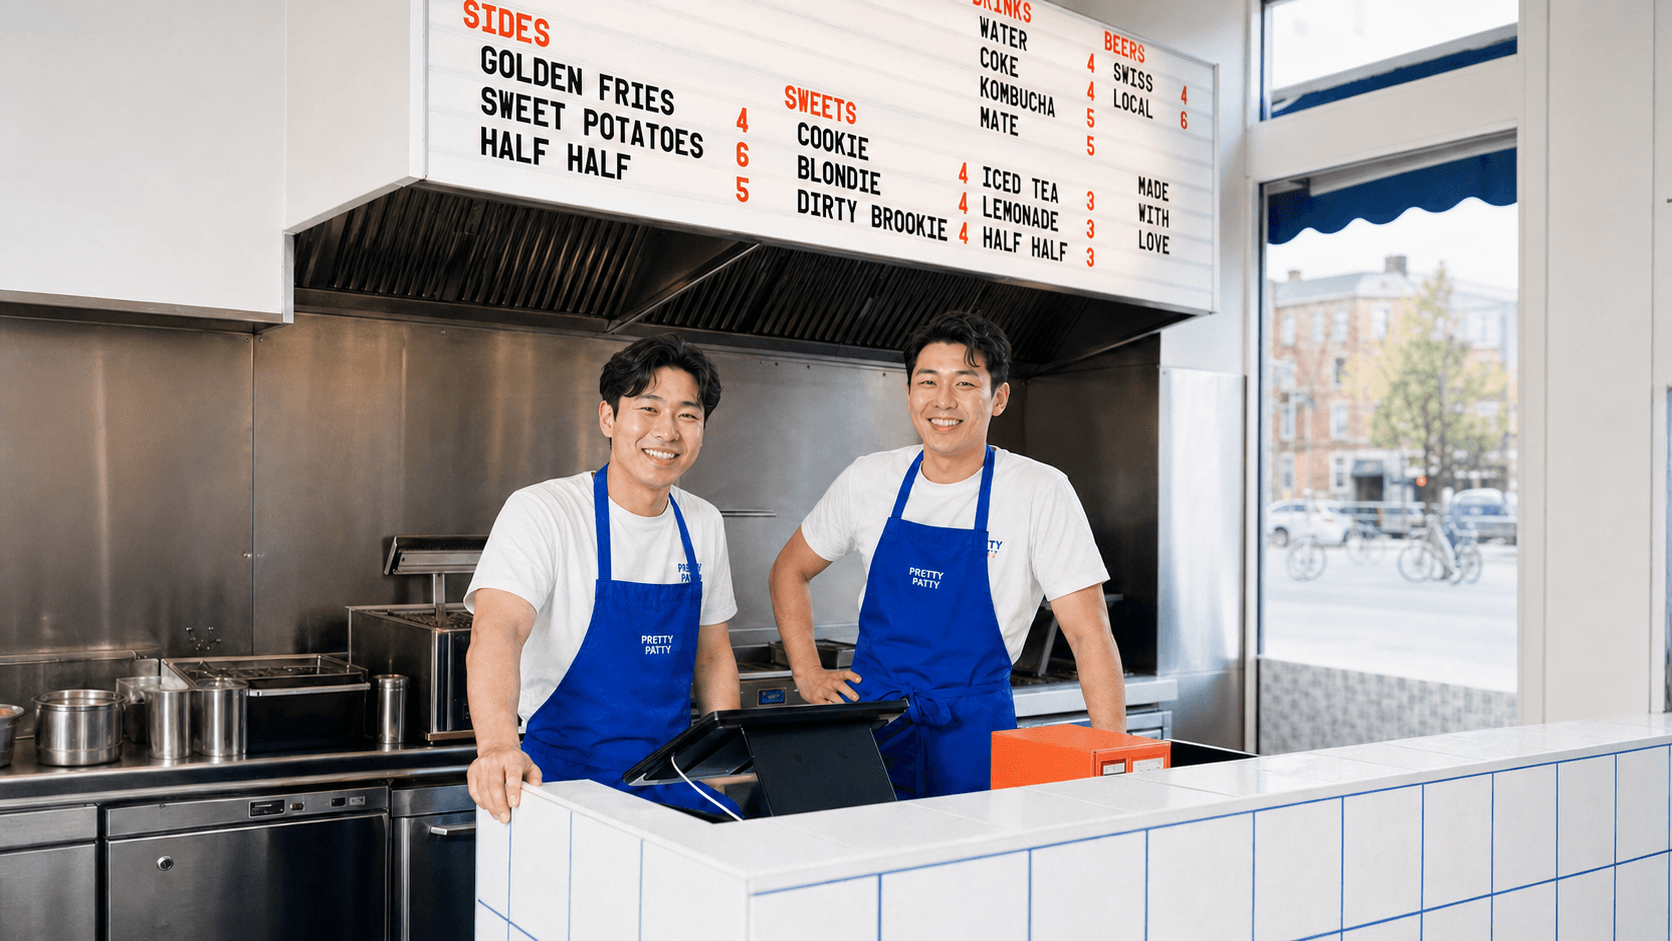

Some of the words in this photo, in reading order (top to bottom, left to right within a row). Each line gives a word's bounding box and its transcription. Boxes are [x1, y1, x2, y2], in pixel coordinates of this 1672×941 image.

[462, 0, 551, 48] SIDES
[972, 0, 1032, 24] INKS
[979, 15, 1028, 52] WATER
[1086, 52, 1096, 75] 4
[1104, 29, 1146, 64] BEERS
[480, 45, 583, 96] GOLDEN
[599, 73, 675, 116] FRIES
[736, 106, 749, 134] 4
[980, 46, 1019, 78] COKE
[1086, 80, 1096, 102] 4
[1113, 62, 1153, 93] SWISS
[1180, 85, 1188, 105] 4
[784, 84, 857, 125] SWEETS
[980, 75, 1056, 118] KOMBUCHA
[1086, 107, 1095, 129] 5
[1113, 88, 1154, 120] LOCAL
[1180, 110, 1188, 130] 6
[480, 86, 566, 131] SWEET
[583, 107, 704, 159] POTATOES
[735, 141, 750, 168] 6
[980, 106, 1019, 137] MATE
[1086, 134, 1095, 157] 5
[480, 126, 550, 166] HALF
[567, 142, 631, 181] HALF
[735, 175, 750, 203] 5
[797, 121, 869, 162] COOKIE
[958, 161, 969, 185] 4
[797, 154, 881, 196] BLONDIE
[958, 191, 969, 215] 4
[982, 165, 1021, 195] ICED
[1031, 177, 1059, 204] TEA
[1086, 190, 1095, 212] 3
[1138, 175, 1169, 202] MADE
[797, 188, 858, 223] DIRTY
[871, 204, 948, 242] BROOKIE
[958, 221, 969, 245] 4
[982, 195, 1059, 232] LEMONADE
[1086, 218, 1095, 240] 3
[1138, 202, 1169, 228] WITH
[983, 225, 1022, 253] HALF
[1031, 236, 1068, 262] HALF
[1086, 246, 1095, 268] 3
[1138, 229, 1170, 255] LOVE
[909, 566, 944, 580] PRETTY
[912, 577, 940, 590] PATTY
[641, 635, 674, 645] PRETTY
[645, 645, 672, 655] PATTY
